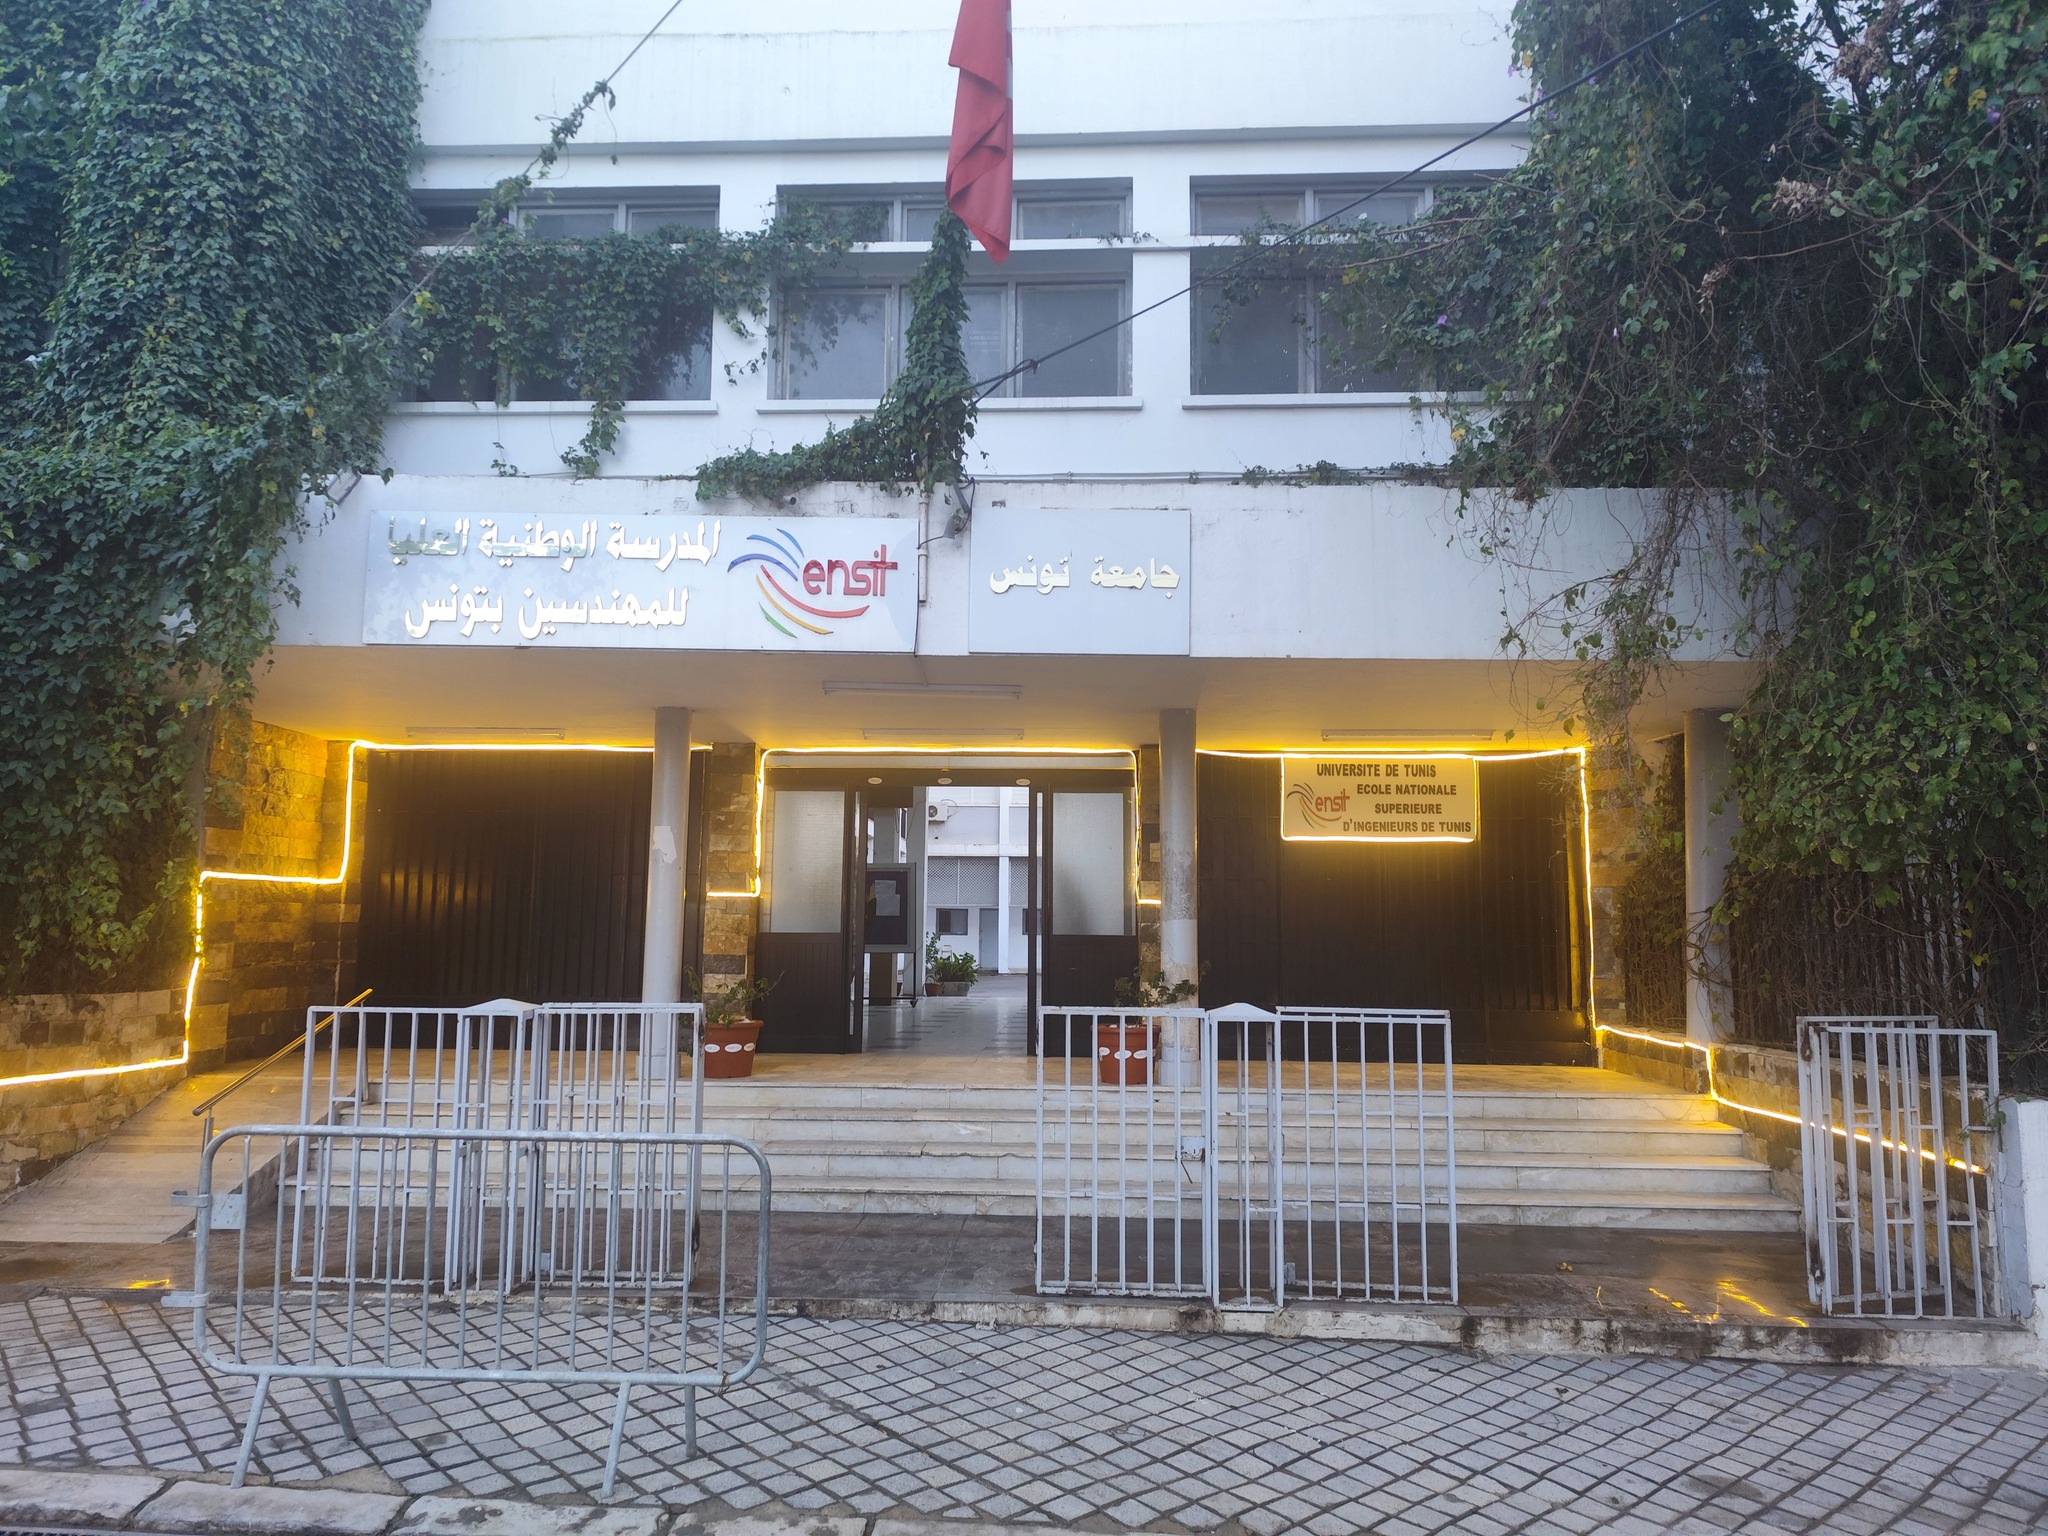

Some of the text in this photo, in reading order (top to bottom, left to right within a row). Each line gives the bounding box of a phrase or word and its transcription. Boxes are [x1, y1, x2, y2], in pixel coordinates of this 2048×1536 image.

[388, 516, 722, 573] المدرسة الوطنية العليا
[802, 543, 899, 597] ensit
[989, 553, 1181, 599] جامعة تونس
[404, 583, 690, 640] للمهندسين بتونس
[1316, 763, 1437, 778] UNIVERSITE DE TUNIS
[1315, 788, 1350, 813] ensit
[1356, 783, 1457, 796] ECOLE NATIONALE
[1374, 803, 1443, 815] SUPERIEURE
[1342, 818, 1472, 833] D'INGENIEURS DE TUNIS
